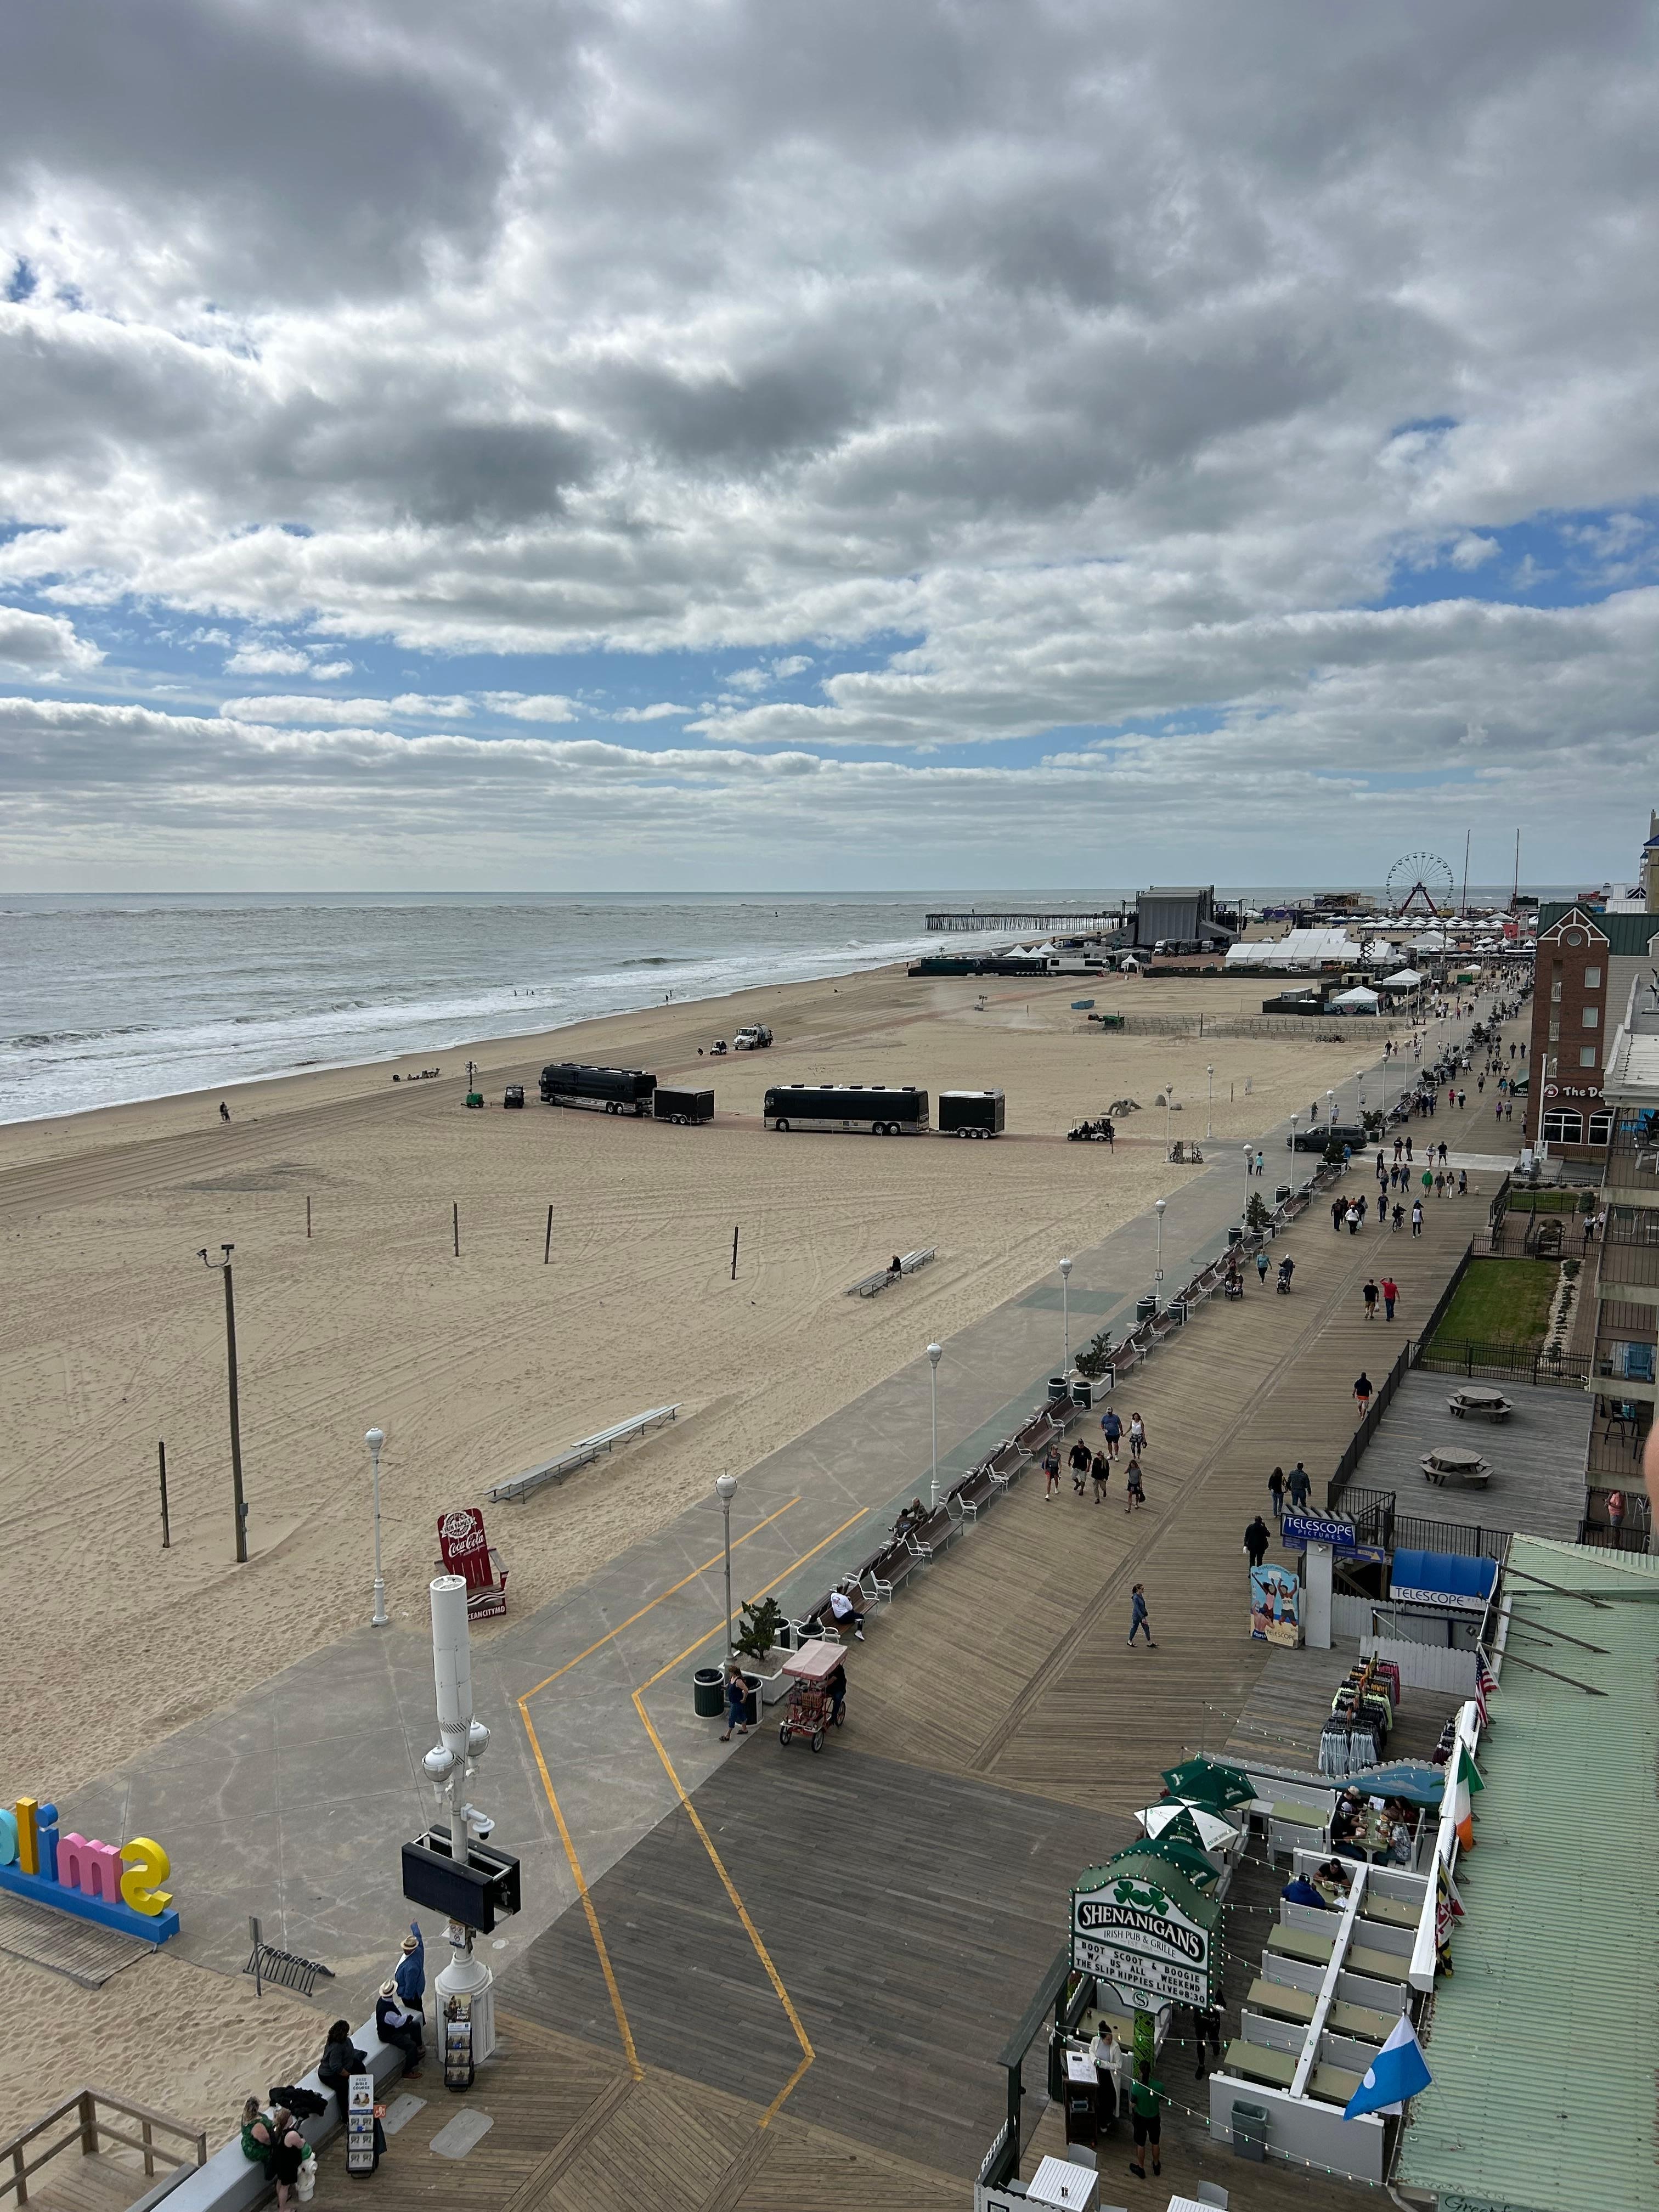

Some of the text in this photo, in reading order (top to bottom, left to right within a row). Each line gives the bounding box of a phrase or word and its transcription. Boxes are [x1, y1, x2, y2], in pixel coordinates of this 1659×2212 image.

[1563, 1086, 1586, 1097] The
[444, 1524, 454, 1532] FUN
[455, 1518, 471, 1528] FAMILY
[1286, 1517, 1352, 1536] TELESCOPE
[1298, 1530, 1341, 1541] PICTURES
[1396, 1587, 1464, 1606] TELESCOPE
[468, 1605, 505, 1620] CEANCITYMD
[1267, 1629, 1295, 1640] TELESCOPE
[1082, 1904, 1199, 1957] SHENANIGAN'S
[1104, 1930, 1176, 1959] IRISH PUB & GRILLE
[1081, 1941, 1200, 1983] BOOT SCOOT & BOOGIE
[1076, 1958, 1091, 1969] THE
[1095, 1963, 1115, 1976] SLIP
[1118, 1971, 1154, 1987] HIPPIES
[1087, 1953, 1200, 1992] W/ US ALL WEEKEND
